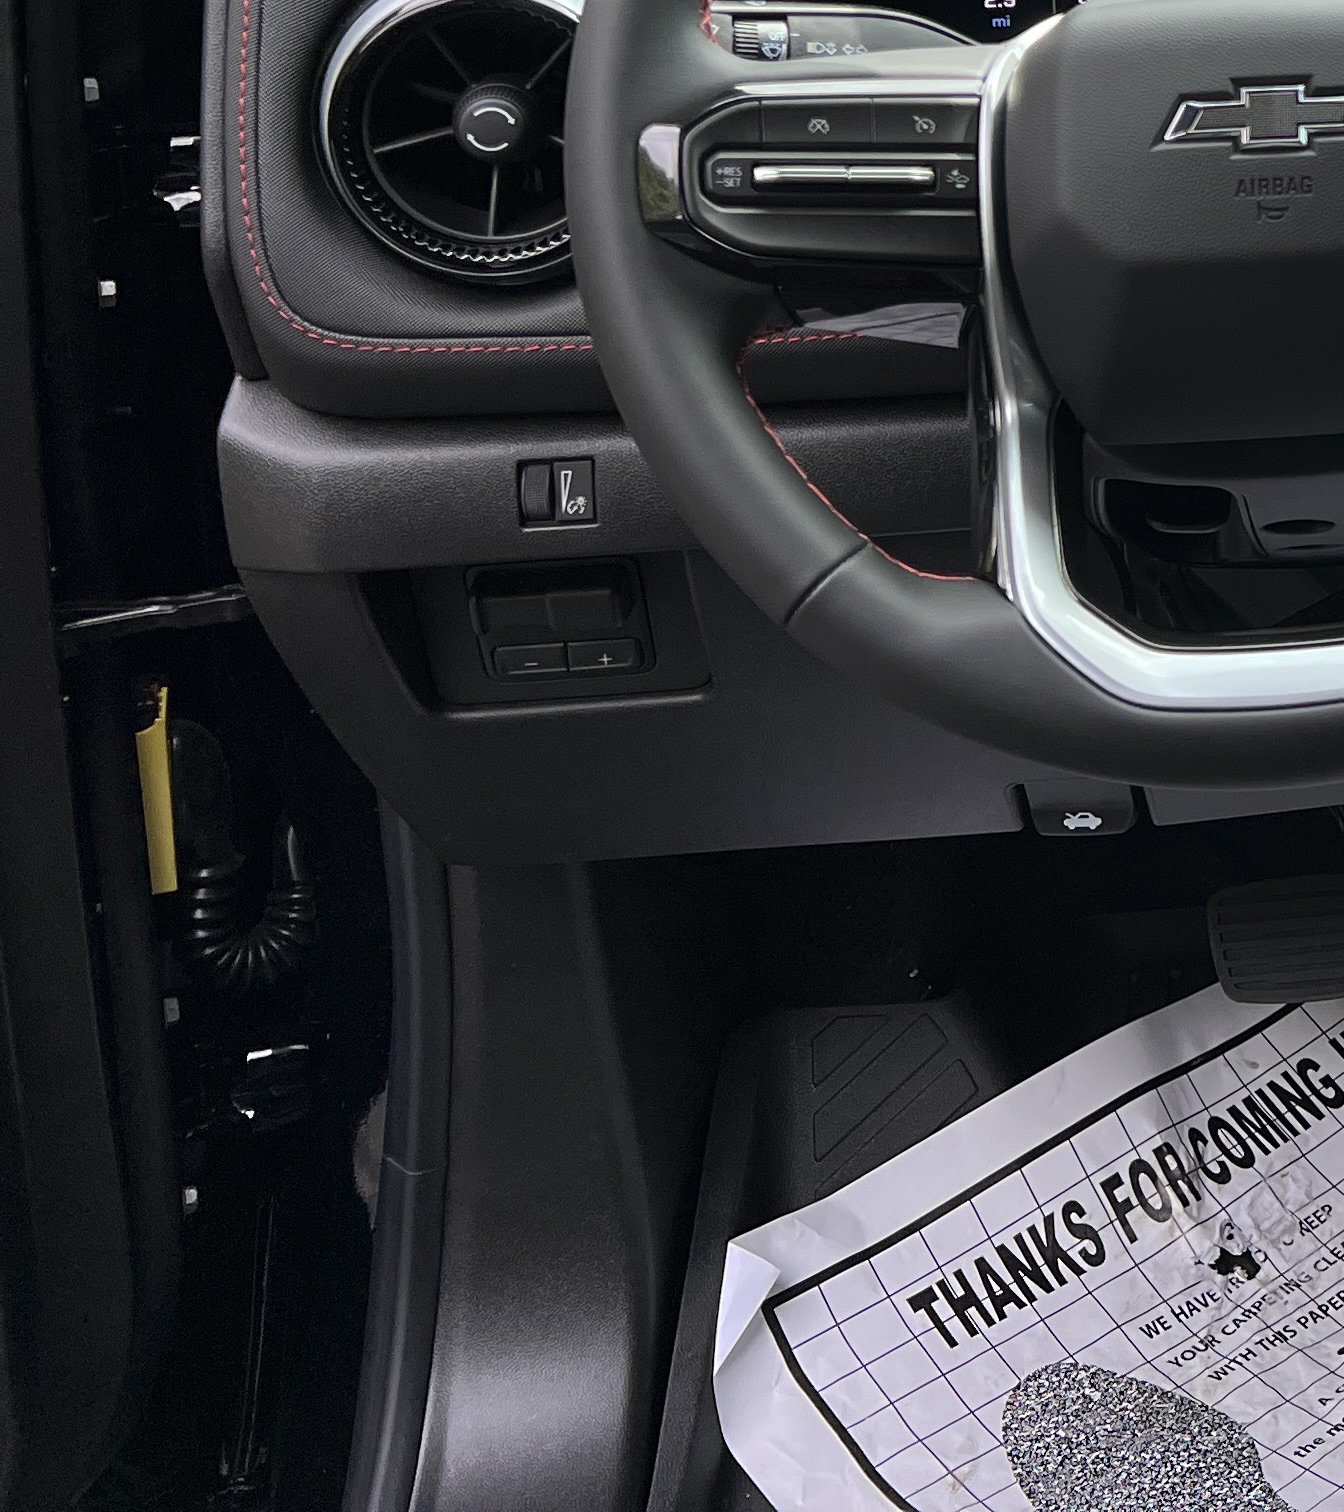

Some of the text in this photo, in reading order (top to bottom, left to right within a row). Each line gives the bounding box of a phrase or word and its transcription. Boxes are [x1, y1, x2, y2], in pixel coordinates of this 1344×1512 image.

[991, 15, 1011, 28] mi
[1235, 176, 1314, 198] AIRBAG
[907, 1199, 1107, 1349] THANKS
[1099, 1141, 1192, 1245] FOR
[1138, 1315, 1173, 1340] WE
[1170, 1289, 1221, 1324] HAVE
[1167, 1333, 1222, 1369] YOUR
[1206, 1346, 1258, 1382] WITH
[1254, 1324, 1298, 1354] THIS
[1317, 1395, 1335, 1407] A
[1293, 1436, 1326, 1459] the
